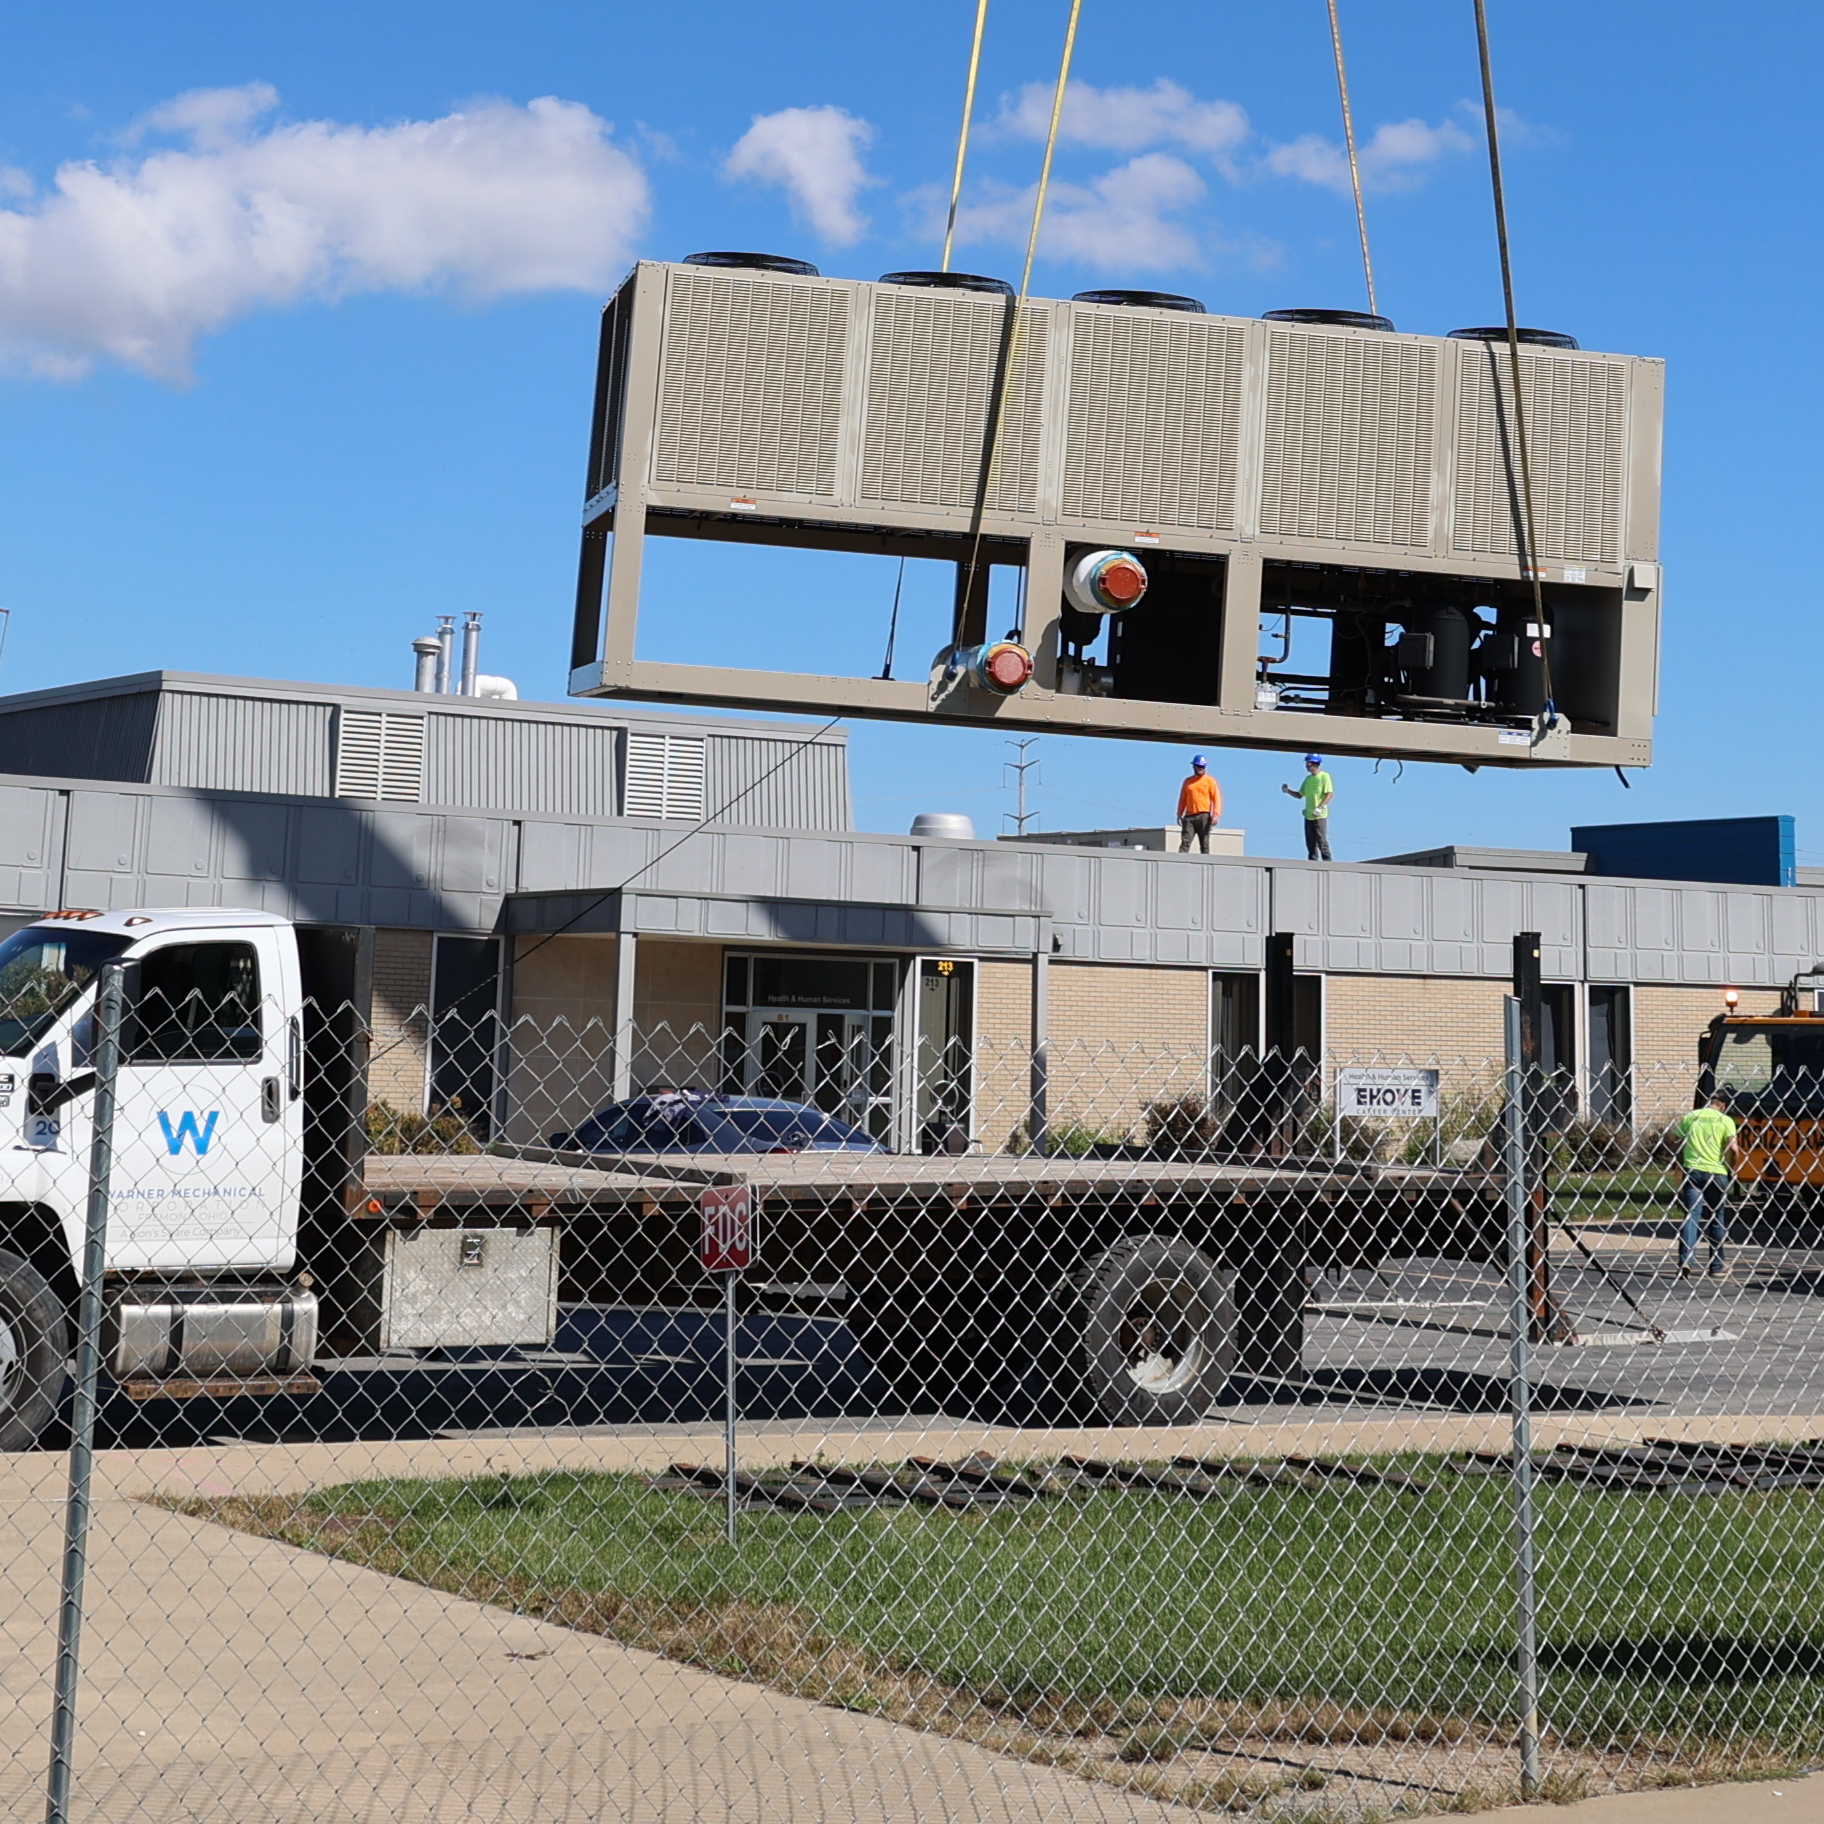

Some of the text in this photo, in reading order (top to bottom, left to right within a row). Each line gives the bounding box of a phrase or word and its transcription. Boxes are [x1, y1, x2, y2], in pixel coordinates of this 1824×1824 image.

[938, 961, 954, 972] 213
[767, 994, 790, 1003] Health
[797, 995, 822, 1004] Human
[822, 996, 851, 1005] Services
[1356, 1087, 1422, 1107] EHOVE
[156, 1110, 220, 1156] W
[171, 1186, 266, 1199] MECHANICAL
[198, 1210, 228, 1222] OHIO
[129, 1229, 159, 1239] ion's
[192, 1226, 241, 1239] Company
[704, 1201, 747, 1255] FDC
